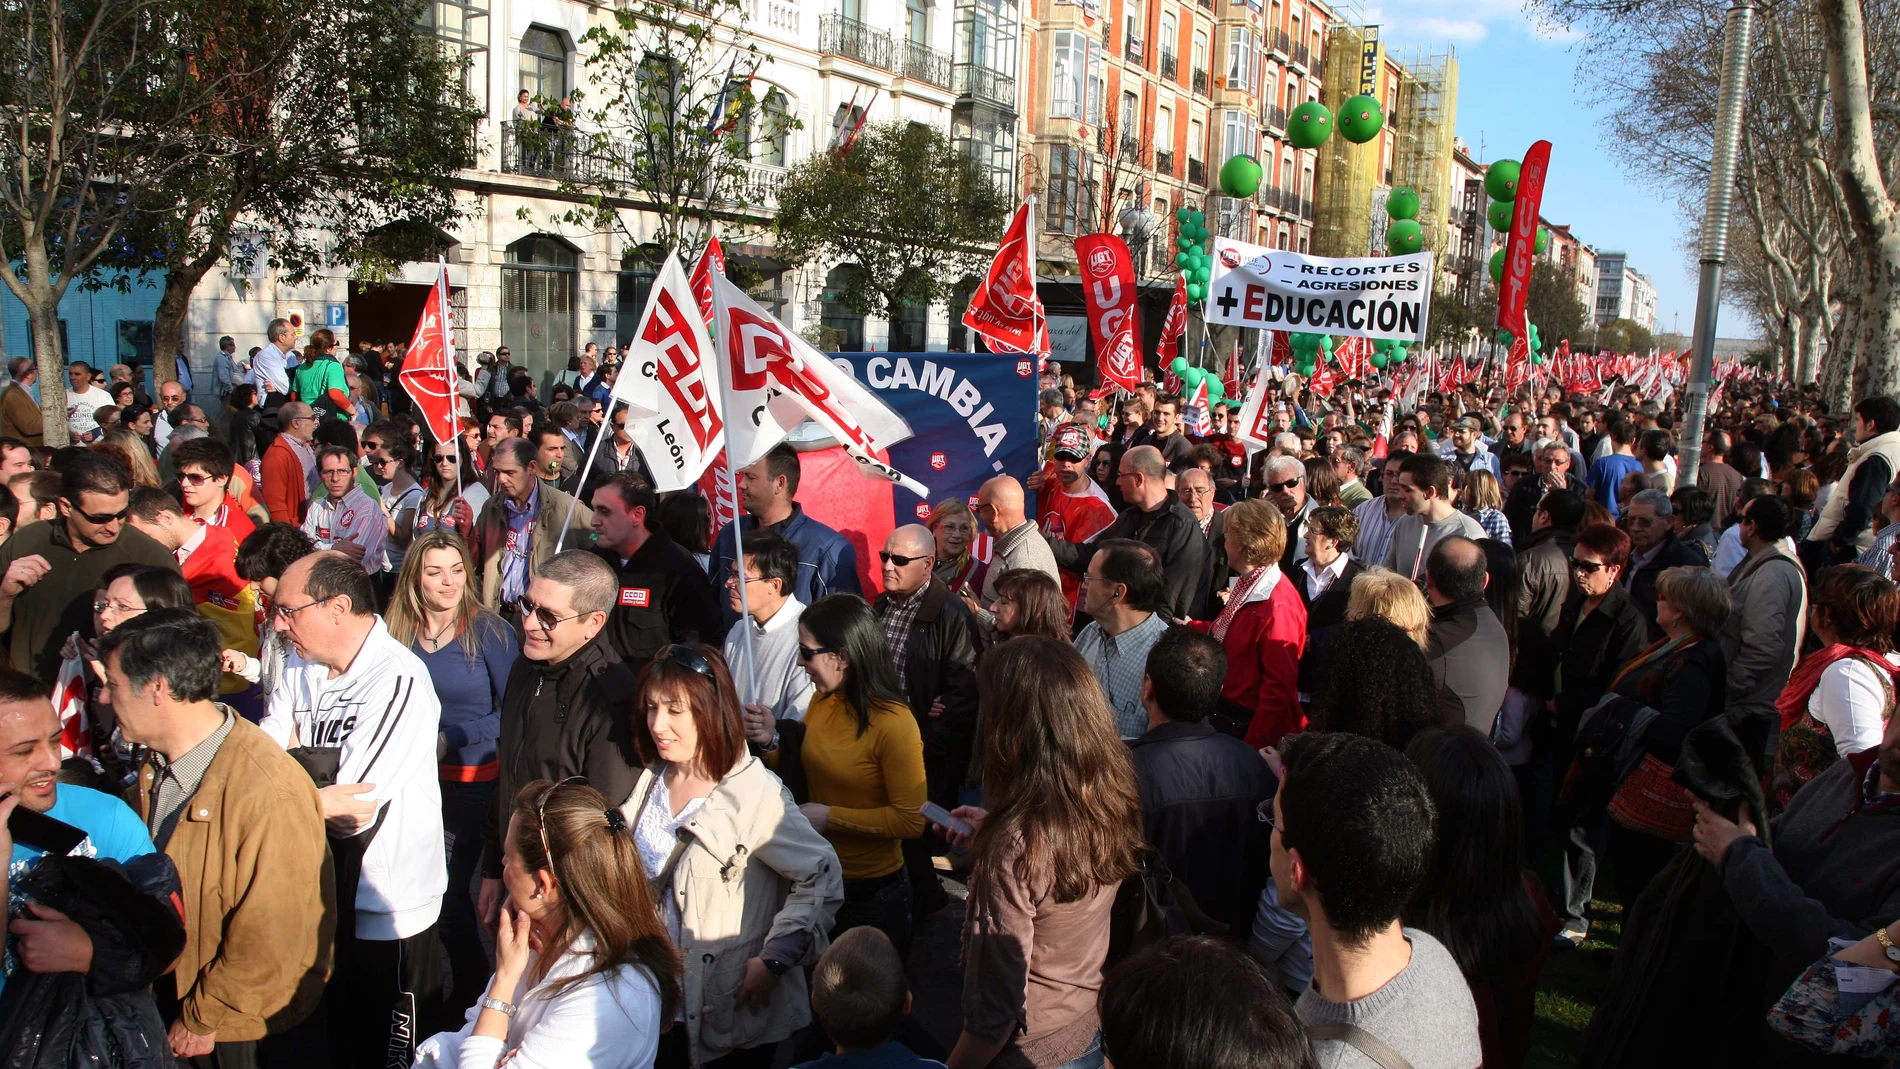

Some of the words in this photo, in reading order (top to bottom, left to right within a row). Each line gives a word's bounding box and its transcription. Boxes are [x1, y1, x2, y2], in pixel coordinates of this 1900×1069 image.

[1362, 43, 1374, 93] ALCA
[1090, 250, 1111, 263] UGT
[1510, 197, 1534, 313] UGT
[1300, 262, 1420, 276] RECORTES
[1297, 279, 1418, 291] AGRESIONES
[332, 306, 341, 325] P
[1093, 275, 1124, 341] UG
[1243, 284, 1420, 334] EDUCACIÓN
[1066, 324, 1082, 336] del
[1017, 361, 1032, 373] UGT
[656, 418, 686, 470] León
[931, 455, 945, 467] UGT
[917, 504, 931, 515] UGT
[385, 1009, 410, 1069] NIK
